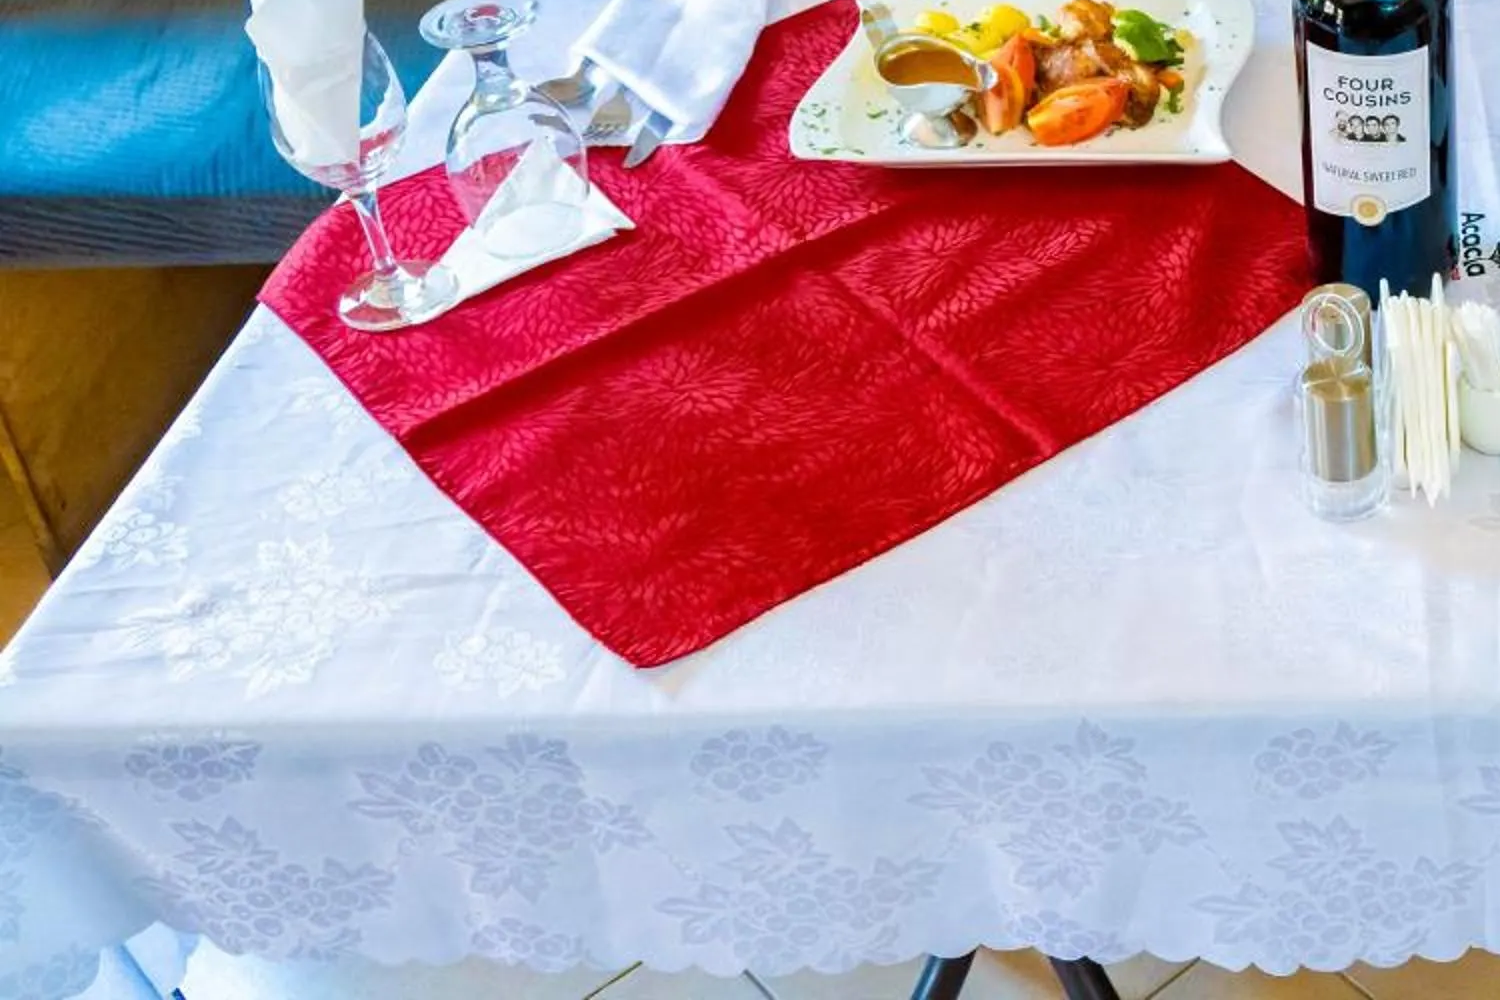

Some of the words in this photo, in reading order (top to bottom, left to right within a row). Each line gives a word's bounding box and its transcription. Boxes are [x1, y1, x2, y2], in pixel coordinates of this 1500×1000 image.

[1337, 75, 1393, 92] FOUR
[1323, 87, 1411, 107] COUSINS
[1461, 212, 1486, 277] Acacia
